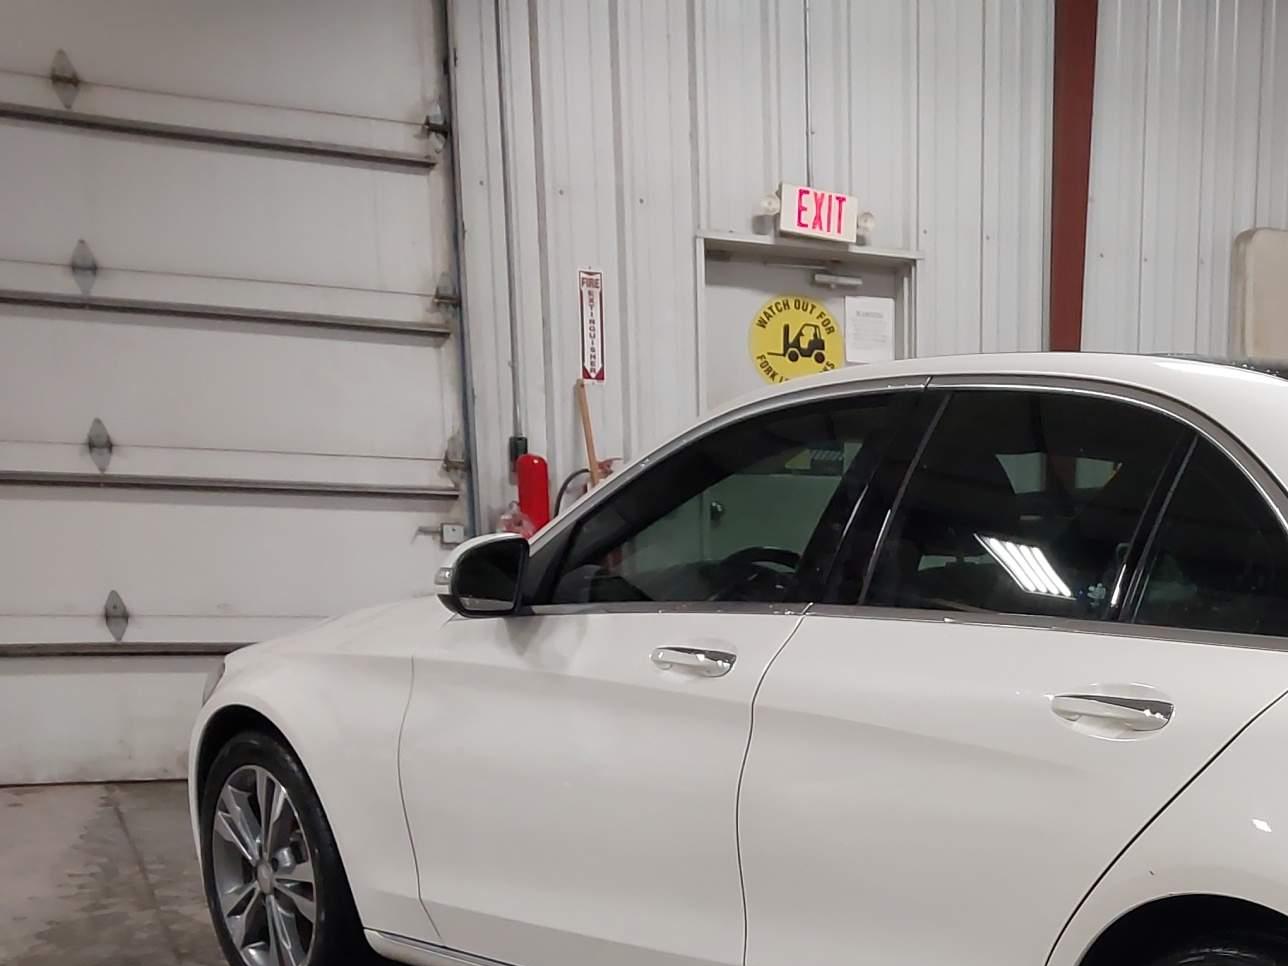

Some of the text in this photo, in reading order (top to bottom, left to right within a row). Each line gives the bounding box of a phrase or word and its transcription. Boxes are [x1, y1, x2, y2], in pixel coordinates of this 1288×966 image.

[797, 189, 846, 234] EXIT
[582, 278, 600, 288] FIRE
[587, 290, 597, 373] EXTINGUISHER
[756, 299, 835, 335] WATCH OUT FOR
[756, 354, 779, 382] FORK
